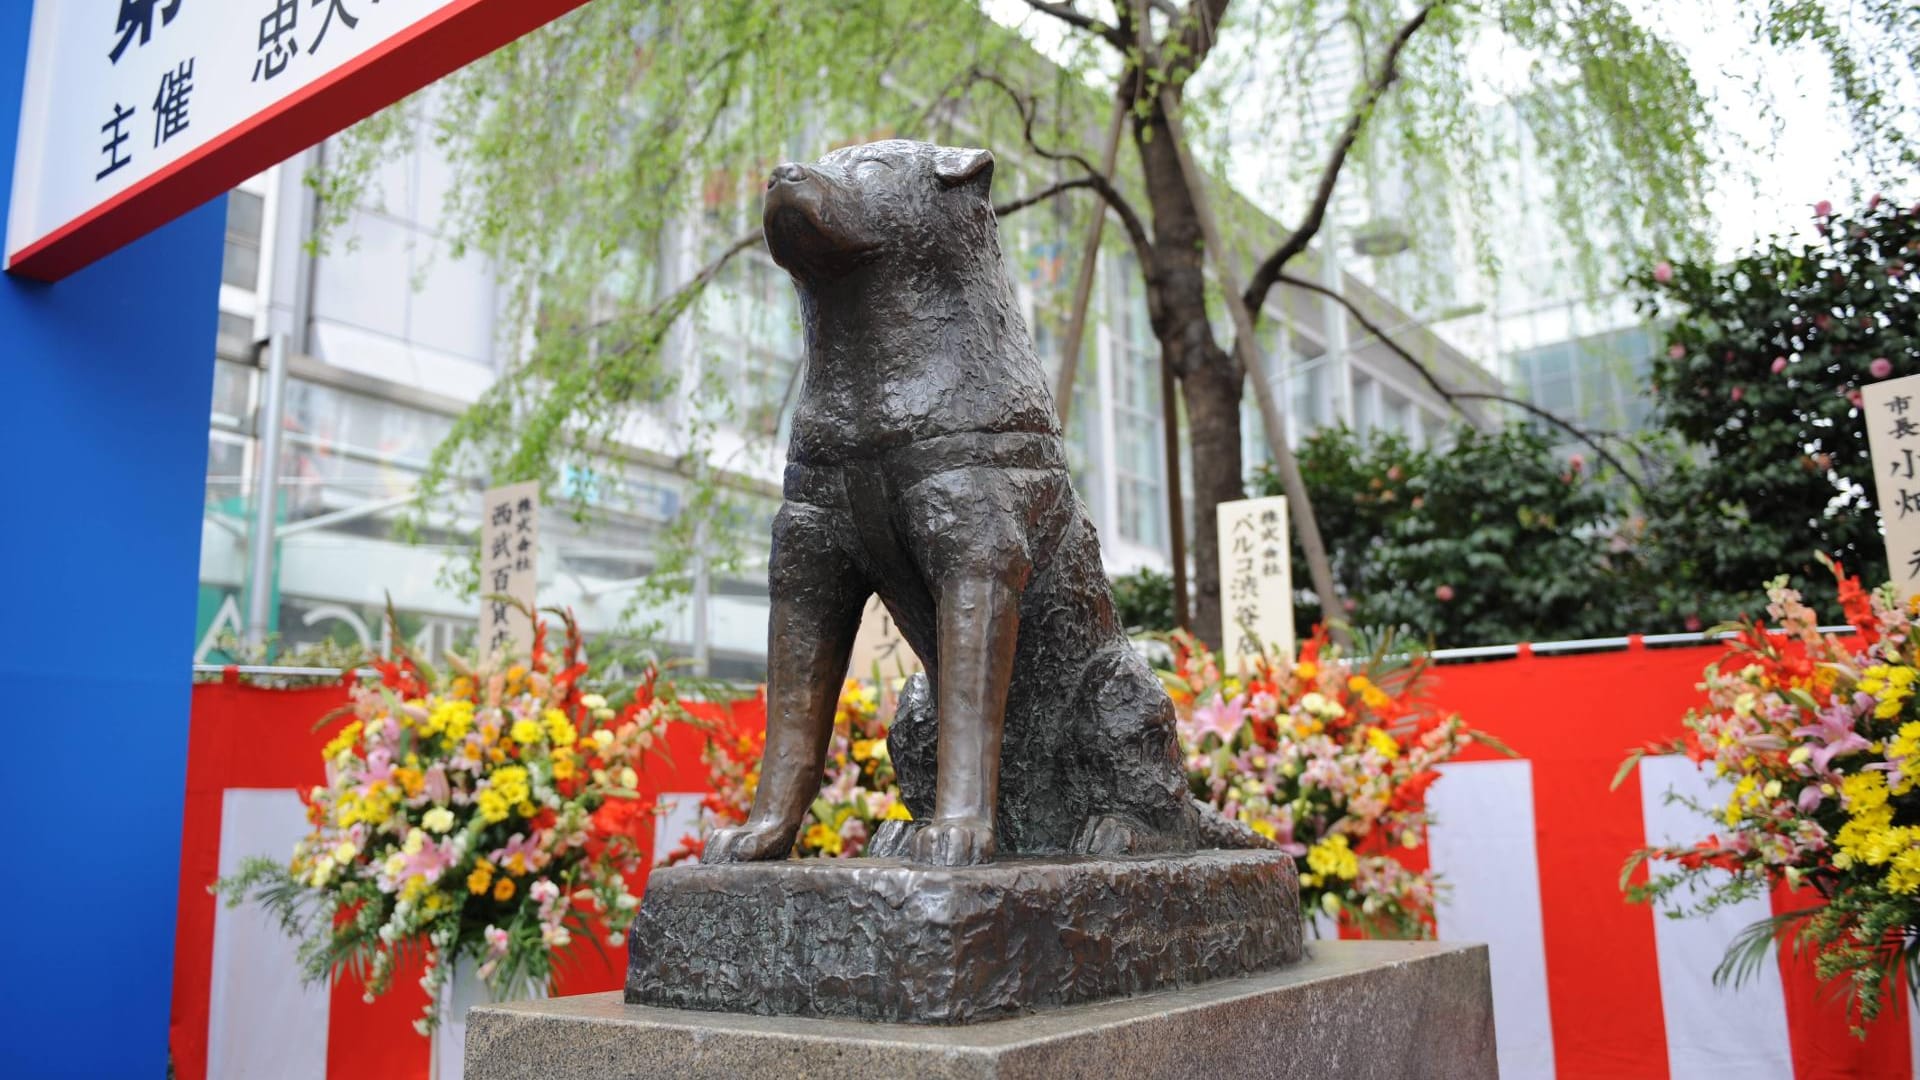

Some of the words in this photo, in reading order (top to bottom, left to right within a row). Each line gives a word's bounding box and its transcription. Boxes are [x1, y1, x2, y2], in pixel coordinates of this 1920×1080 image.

[96, 56, 196, 182] 主催
[516, 497, 532, 571] 株式会社
[1260, 510, 1282, 576] 株式会社
